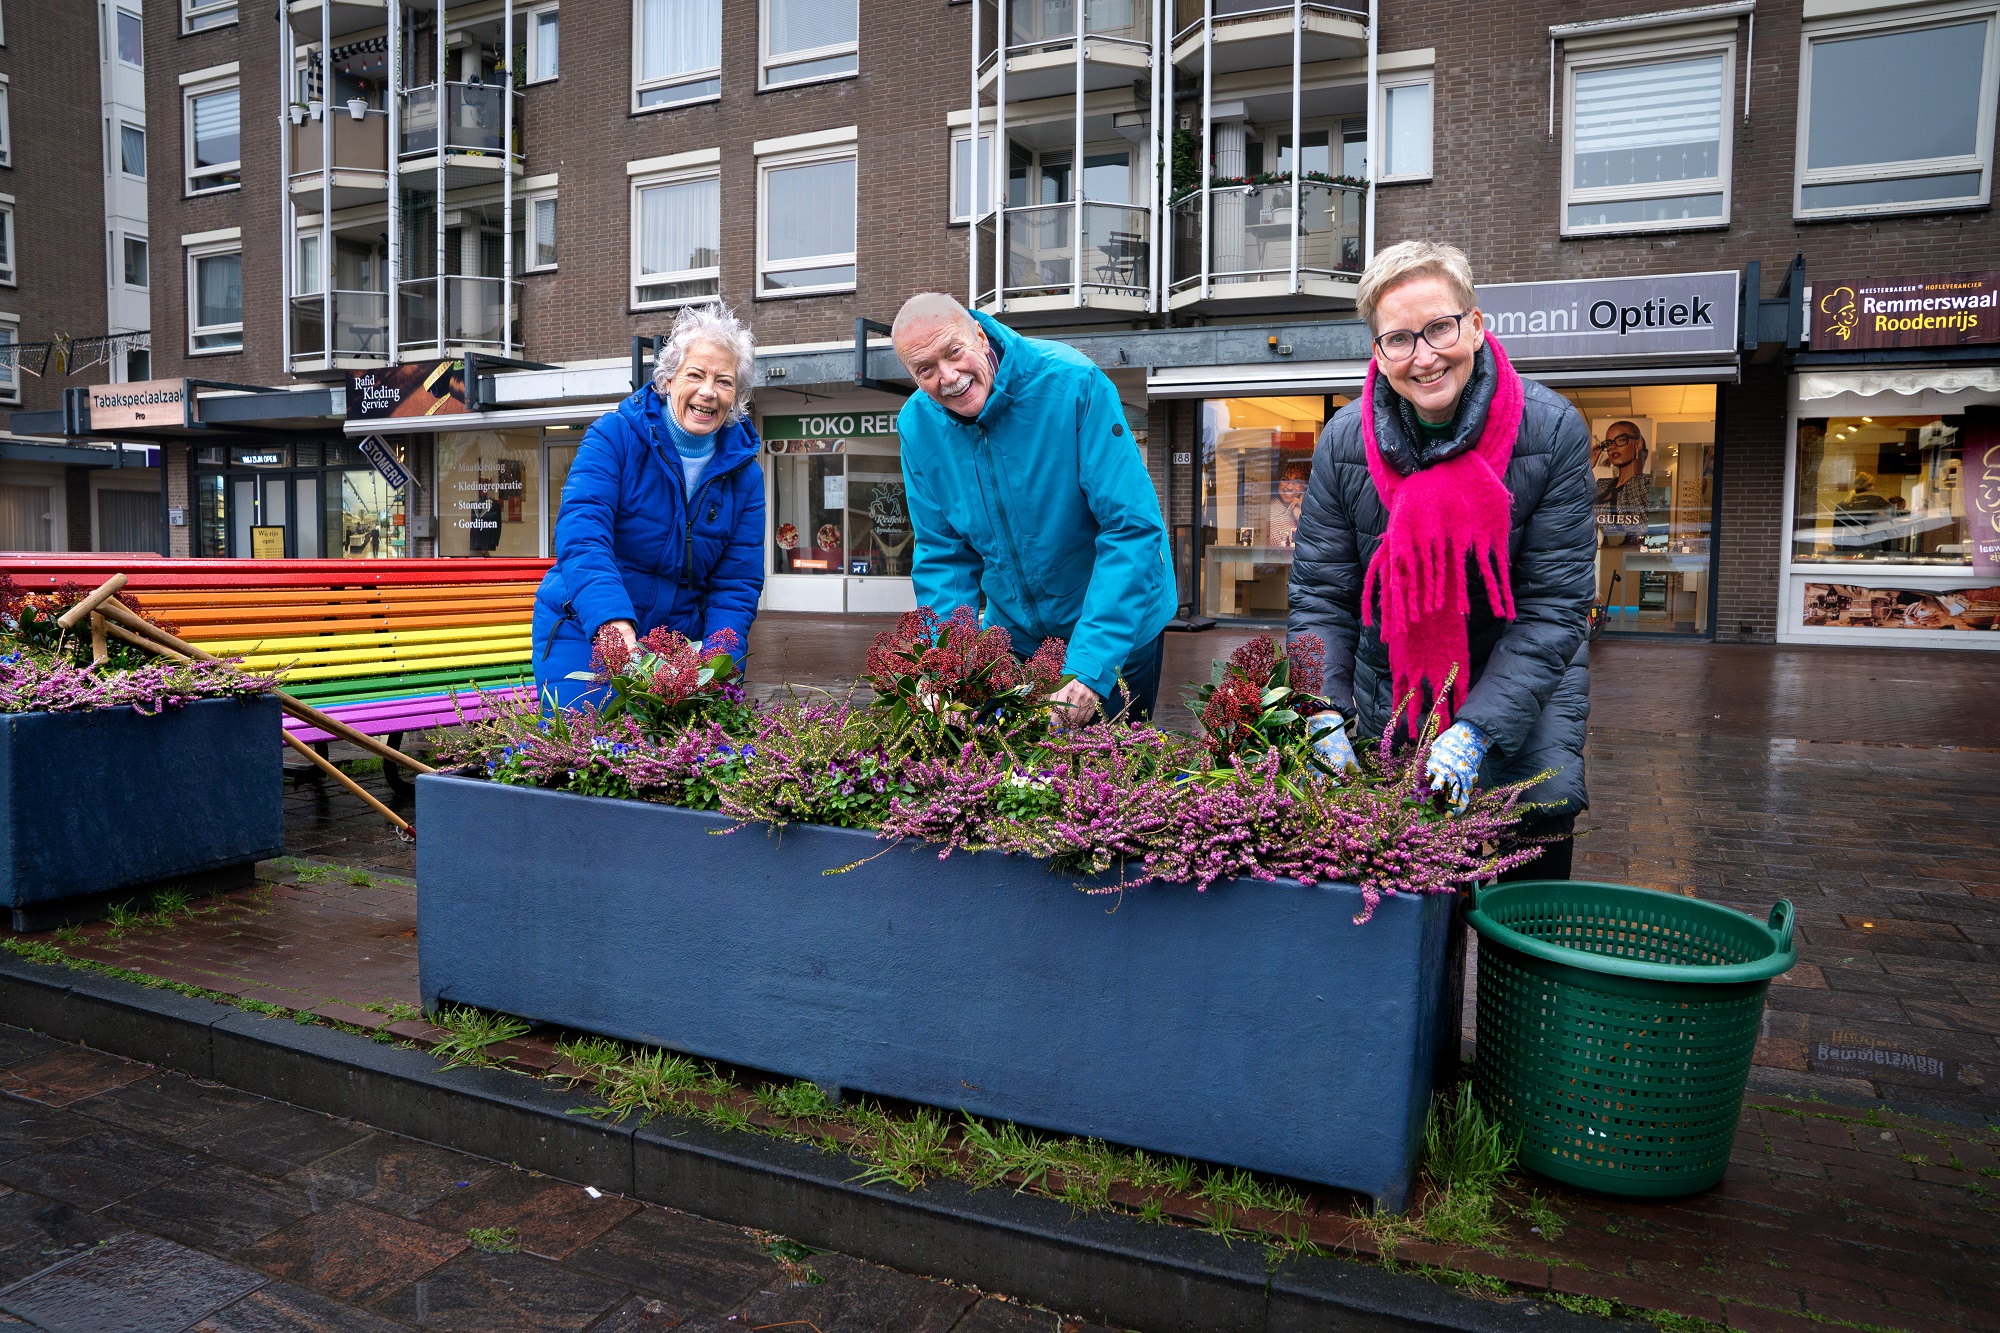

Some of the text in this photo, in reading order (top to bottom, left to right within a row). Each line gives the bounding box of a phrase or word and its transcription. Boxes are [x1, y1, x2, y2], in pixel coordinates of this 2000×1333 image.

[1860, 282, 1983, 294] MEESTERBAKKER HOFLEVERANCIER
[1863, 290, 1998, 314] Remmerswaal
[1588, 295, 1715, 336] Optiek
[1875, 311, 1978, 332] Roodenrijs
[354, 375, 375, 390] Rafid
[93, 388, 184, 408] Tabakspeciaalzaak
[363, 385, 400, 402] Kleding
[361, 400, 389, 414] Service
[135, 412, 146, 420] Pro
[798, 416, 855, 436] TOKO
[263, 455, 277, 463] OPEN
[364, 440, 404, 487] STOMERIJ
[1174, 453, 1190, 463] 188
[458, 463, 506, 474] Maatkleding
[458, 480, 523, 493] Kledingreparatie
[458, 500, 491, 512] Stomerij
[458, 518, 498, 531] Gordijnen
[1596, 514, 1640, 525] GUESS
